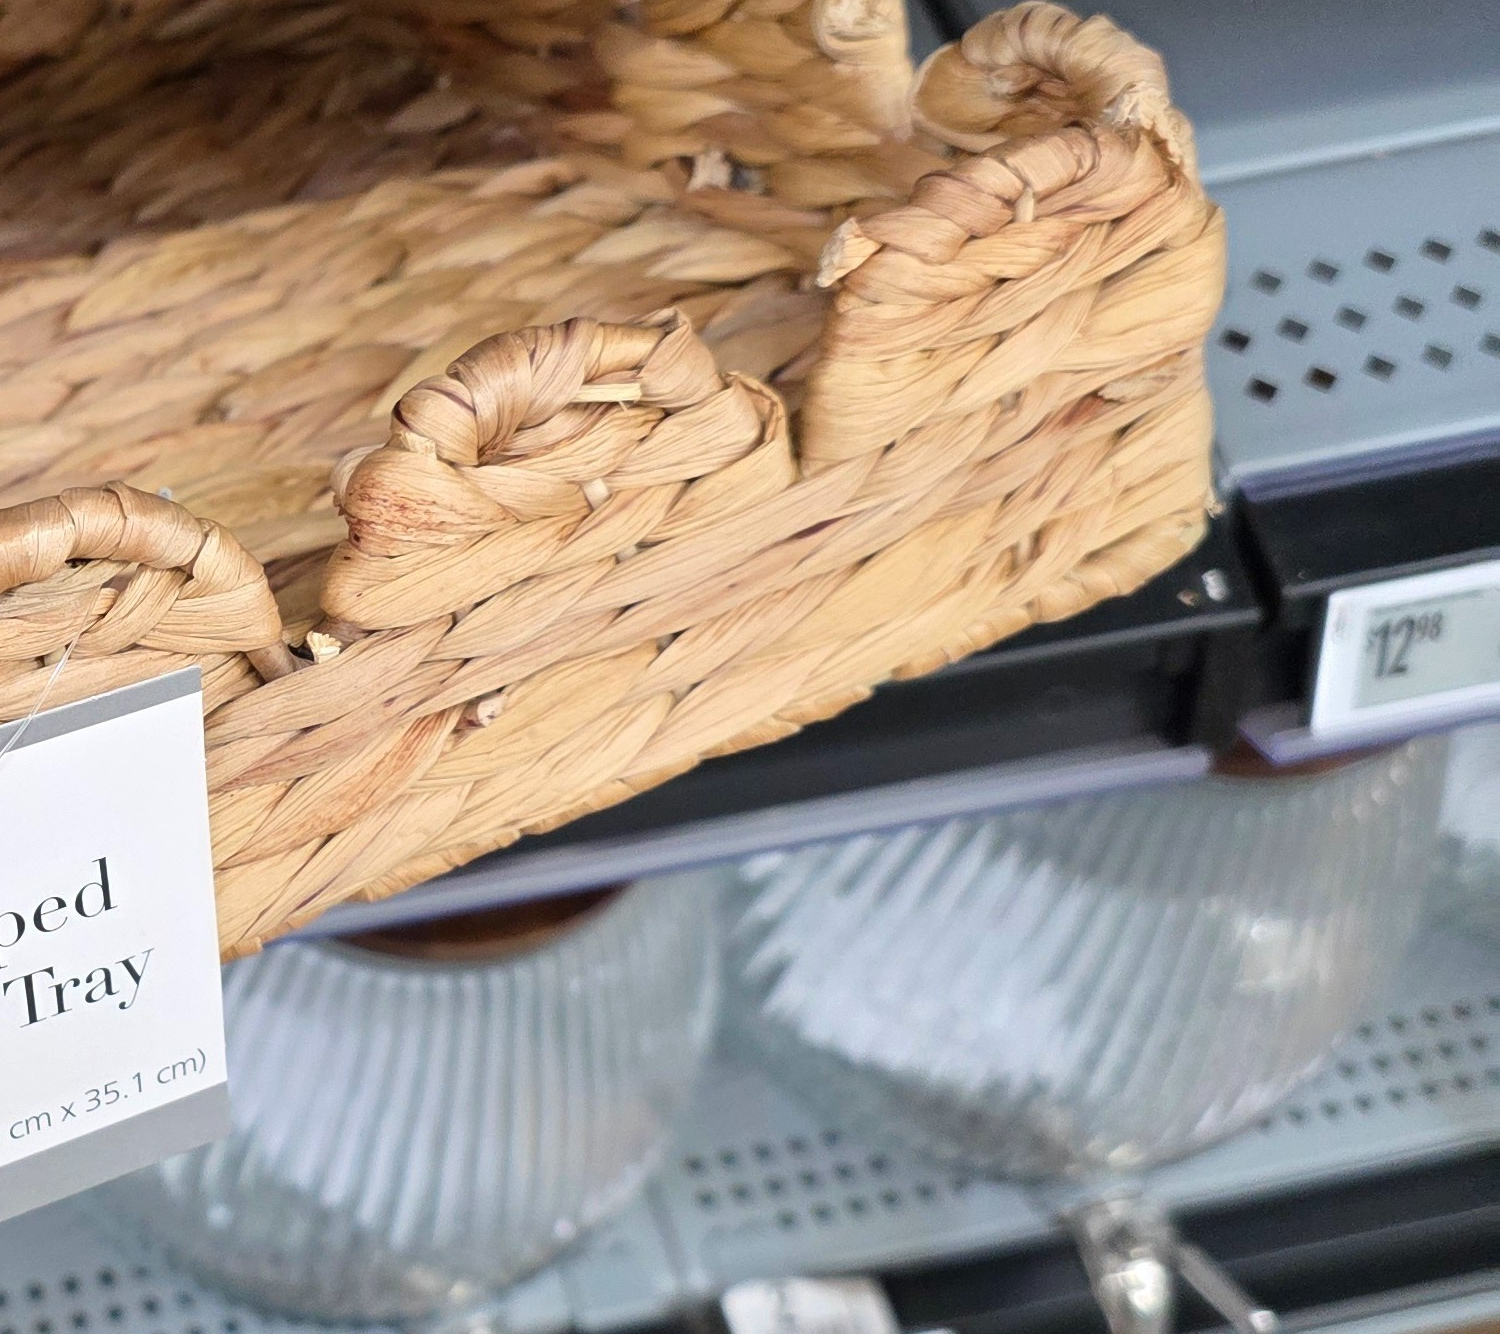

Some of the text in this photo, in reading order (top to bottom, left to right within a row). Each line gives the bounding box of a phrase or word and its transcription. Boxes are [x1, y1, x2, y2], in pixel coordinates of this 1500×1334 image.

[2, 947, 156, 1029] Tray
[9, 1111, 52, 1140] cm
[60, 1101, 77, 1123] x
[84, 1071, 143, 1113] 35.1
[156, 1047, 207, 1085] cm)
